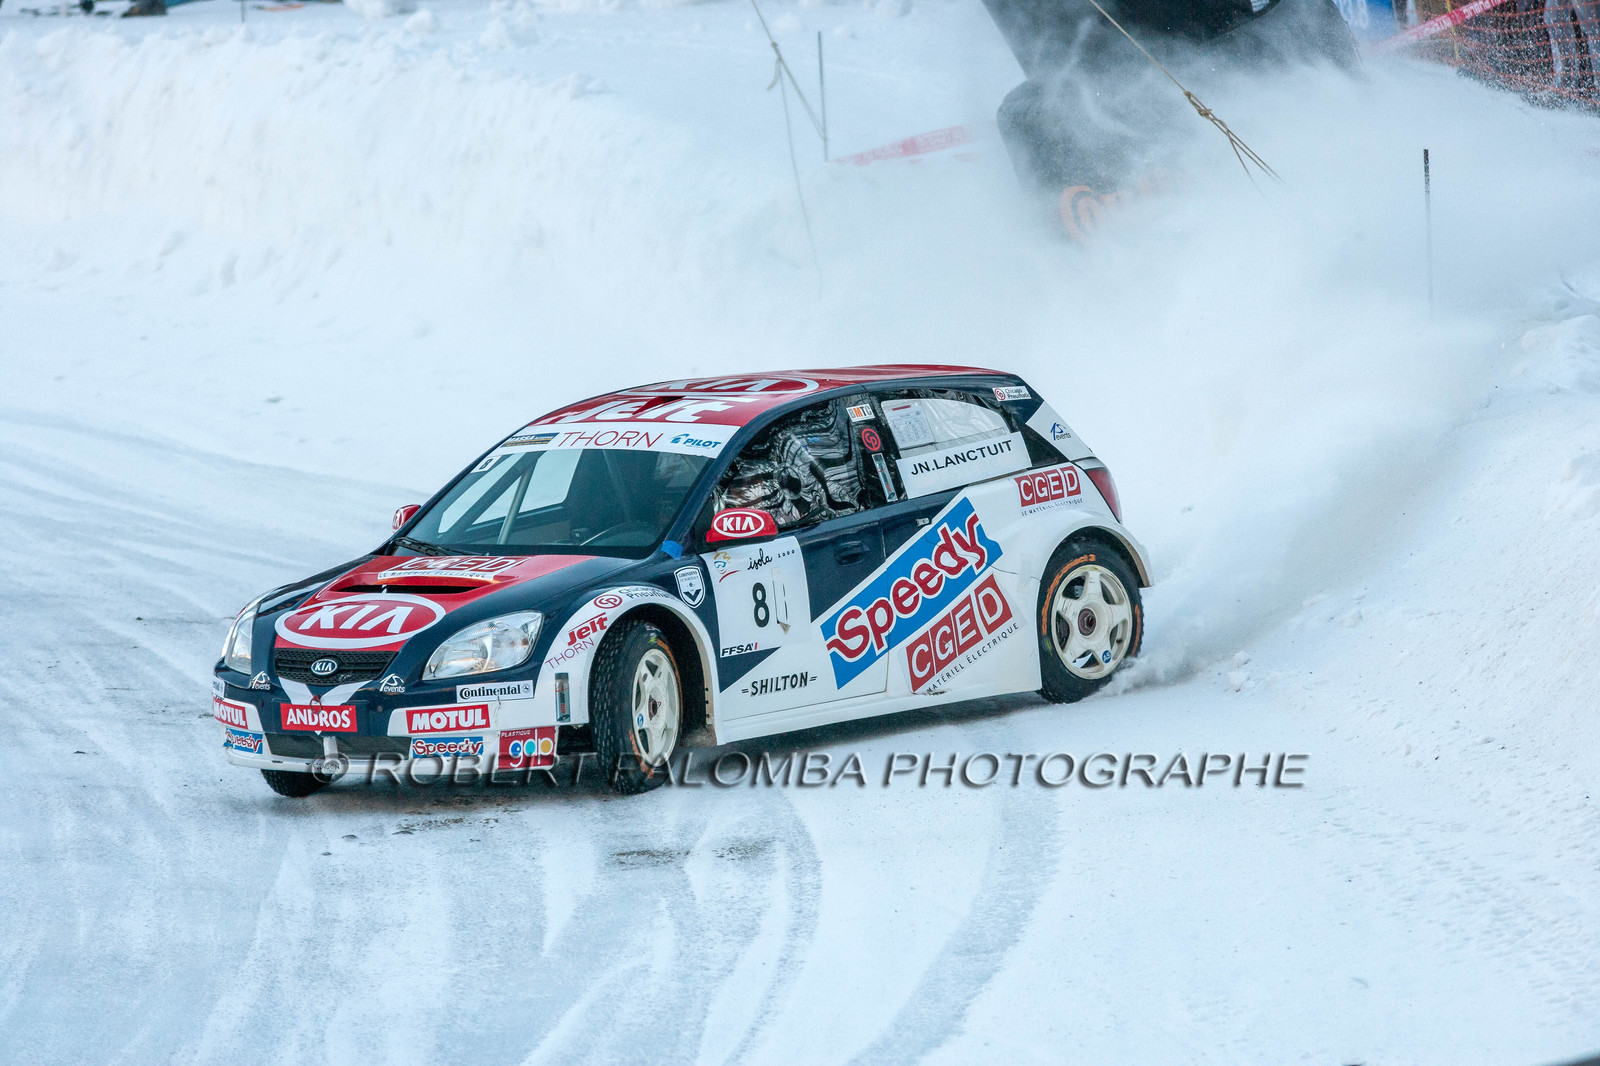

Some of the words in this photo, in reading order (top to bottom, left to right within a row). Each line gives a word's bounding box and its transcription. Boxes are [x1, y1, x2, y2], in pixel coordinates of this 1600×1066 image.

[849, 406, 873, 420] BMTC
[558, 430, 664, 448] THORN
[682, 437, 722, 449] PILOT
[1056, 432, 1072, 441] events
[910, 439, 1013, 476] JN.LANCTUIT
[1020, 469, 1079, 502] CGED
[722, 516, 756, 532] KIA
[747, 548, 773, 571] isola
[777, 549, 796, 559] 2000
[826, 513, 987, 659] Speedy
[752, 582, 770, 628] 8
[298, 604, 414, 634] KIA
[911, 586, 1004, 679] CGED
[544, 637, 595, 669] THORN
[721, 644, 753, 657] FFSA
[926, 662, 965, 692] MATÉRIEL
[966, 622, 1019, 664] ÉLECTRIQUE
[314, 661, 333, 672] KIA
[254, 682, 271, 691] events
[383, 684, 406, 693] events
[459, 684, 522, 700] Continental
[213, 700, 246, 727] MOTUL
[286, 708, 351, 728] ANDROS
[411, 708, 487, 731] MOTUL
[224, 730, 263, 753] Speedy
[500, 729, 531, 738] PLASTIQUE
[412, 739, 484, 756] Speedy
[509, 728, 554, 768] gdp
